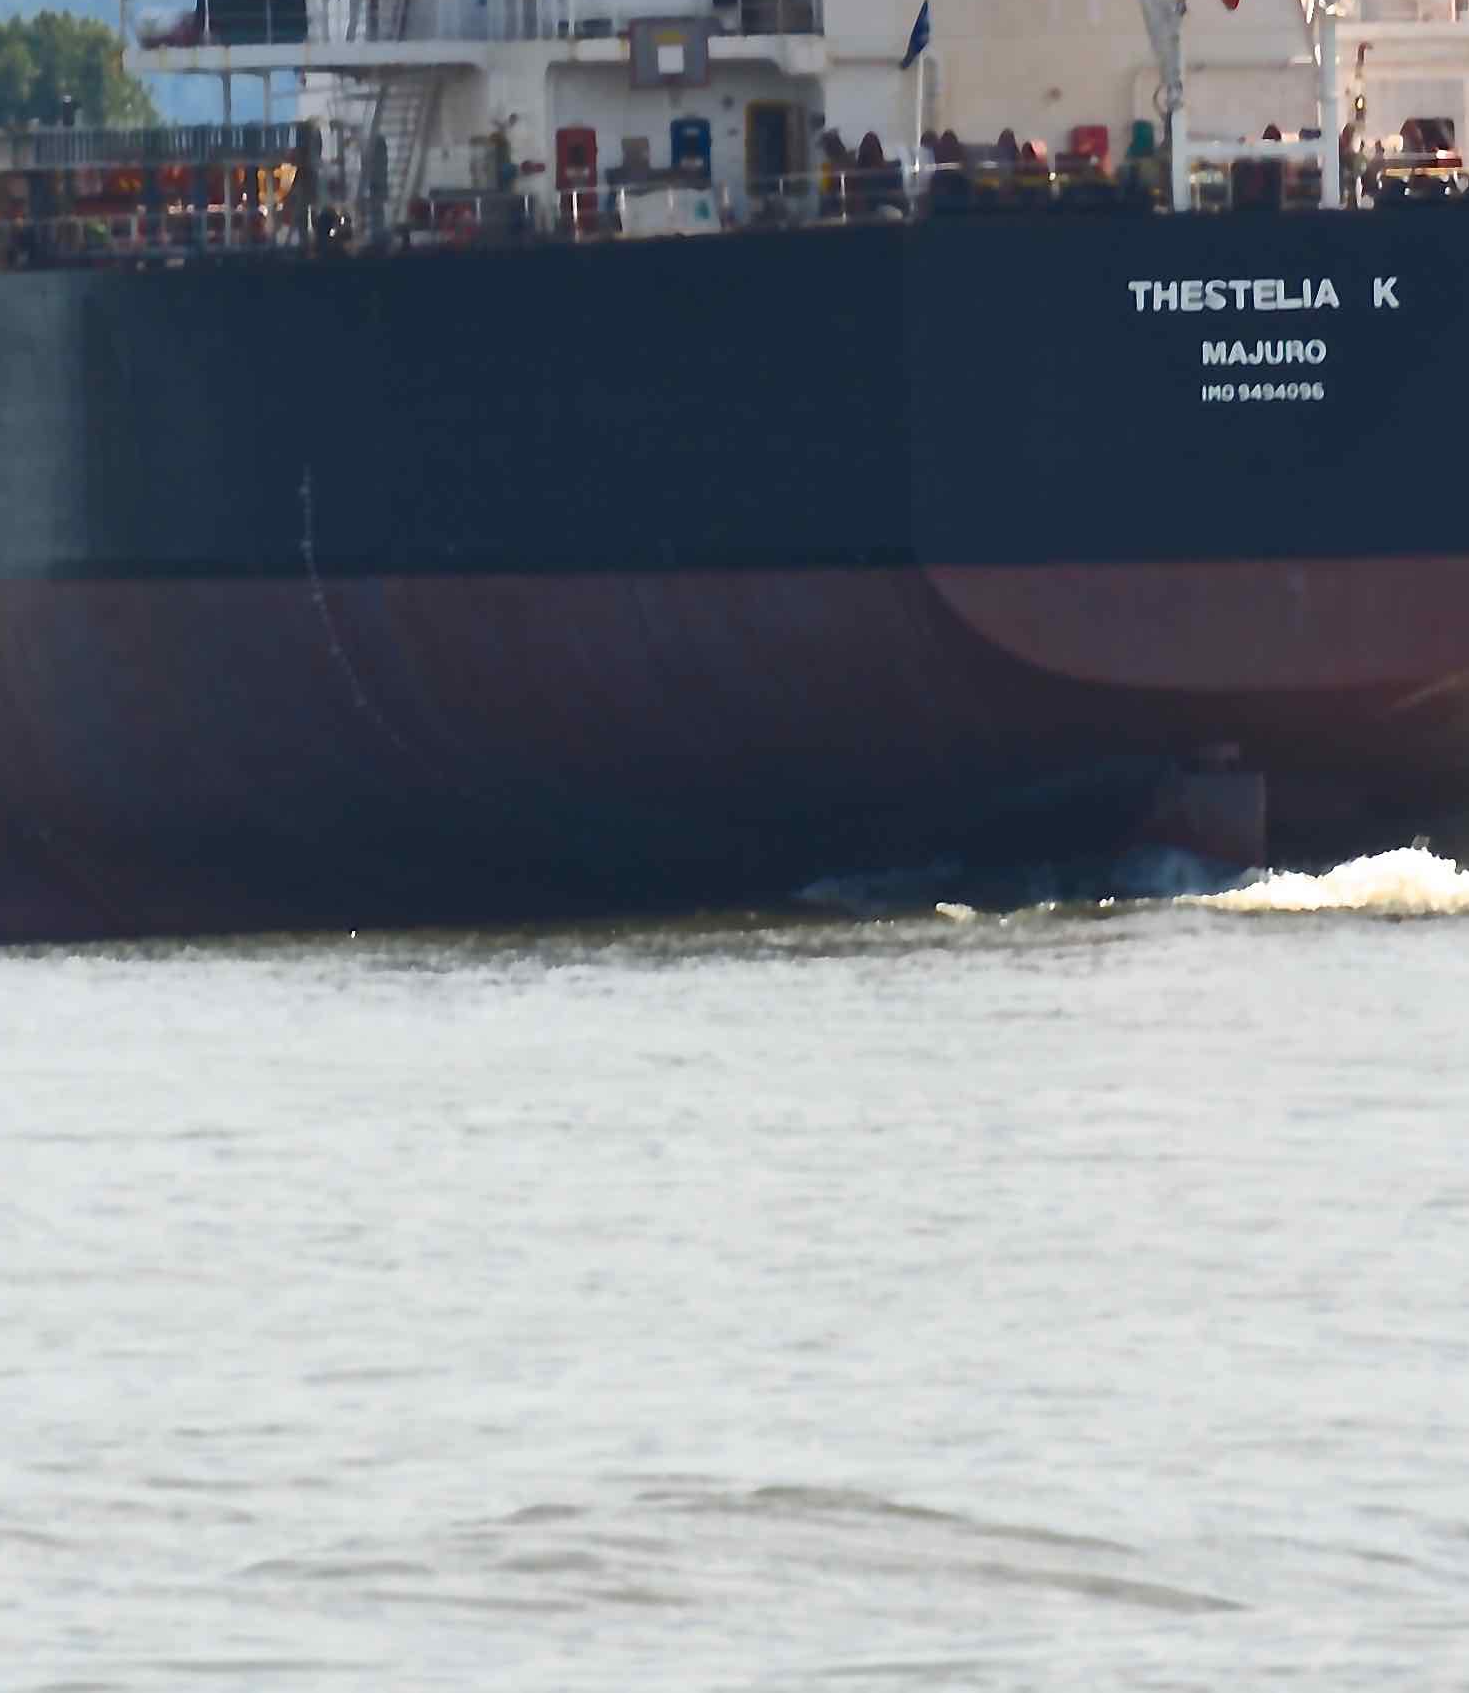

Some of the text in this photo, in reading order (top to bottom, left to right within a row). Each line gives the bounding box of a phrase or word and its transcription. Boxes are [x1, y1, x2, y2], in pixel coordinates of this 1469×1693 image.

[1127, 276, 1400, 312] THESTELIA K
[1201, 338, 1327, 366] MAJURO
[1201, 383, 1235, 403] IMO
